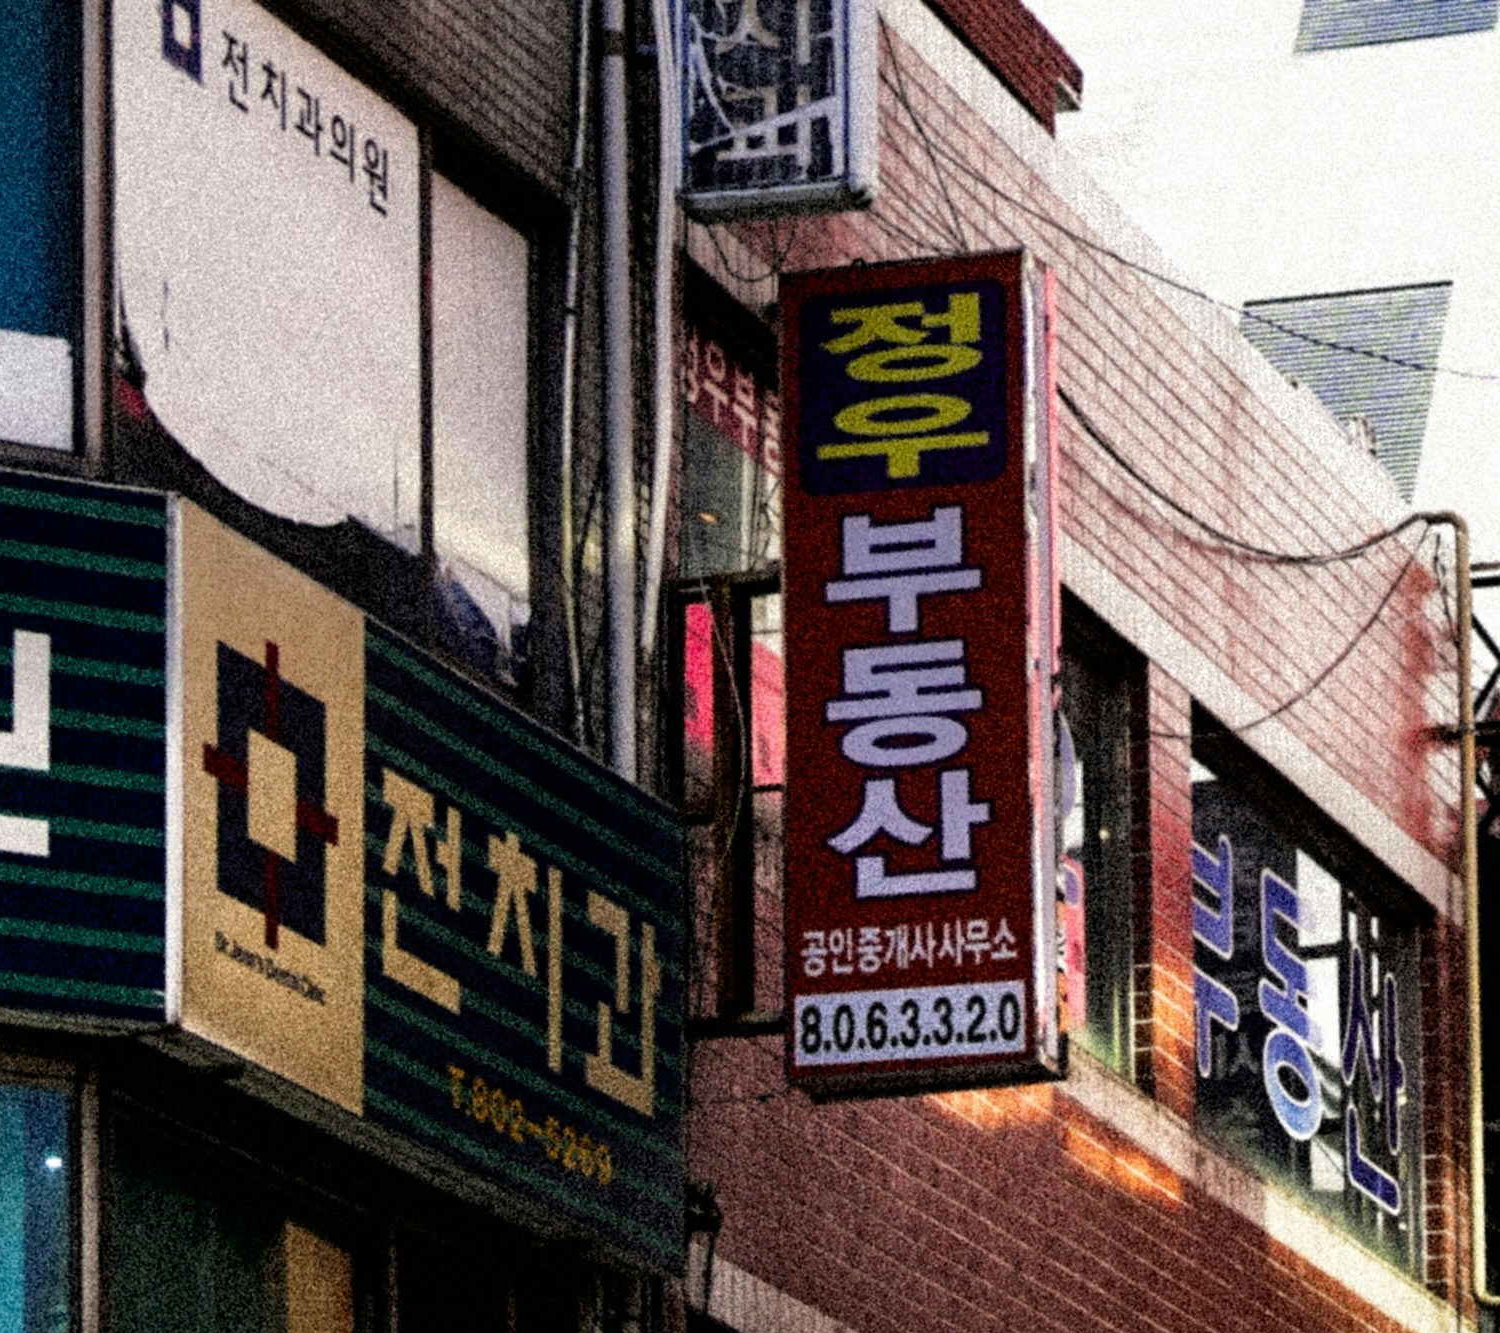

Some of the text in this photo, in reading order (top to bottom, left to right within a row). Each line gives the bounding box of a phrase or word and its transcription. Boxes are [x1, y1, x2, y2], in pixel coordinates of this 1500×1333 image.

[222, 30, 391, 216] 전치과의원
[816, 292, 989, 478] 정우
[825, 506, 991, 898] 부동산
[383, 767, 659, 1117] 전치과
[801, 918, 1017, 976] 공인중개사사무소
[801, 993, 1020, 1054] 8.0.6.3.3.2.0
